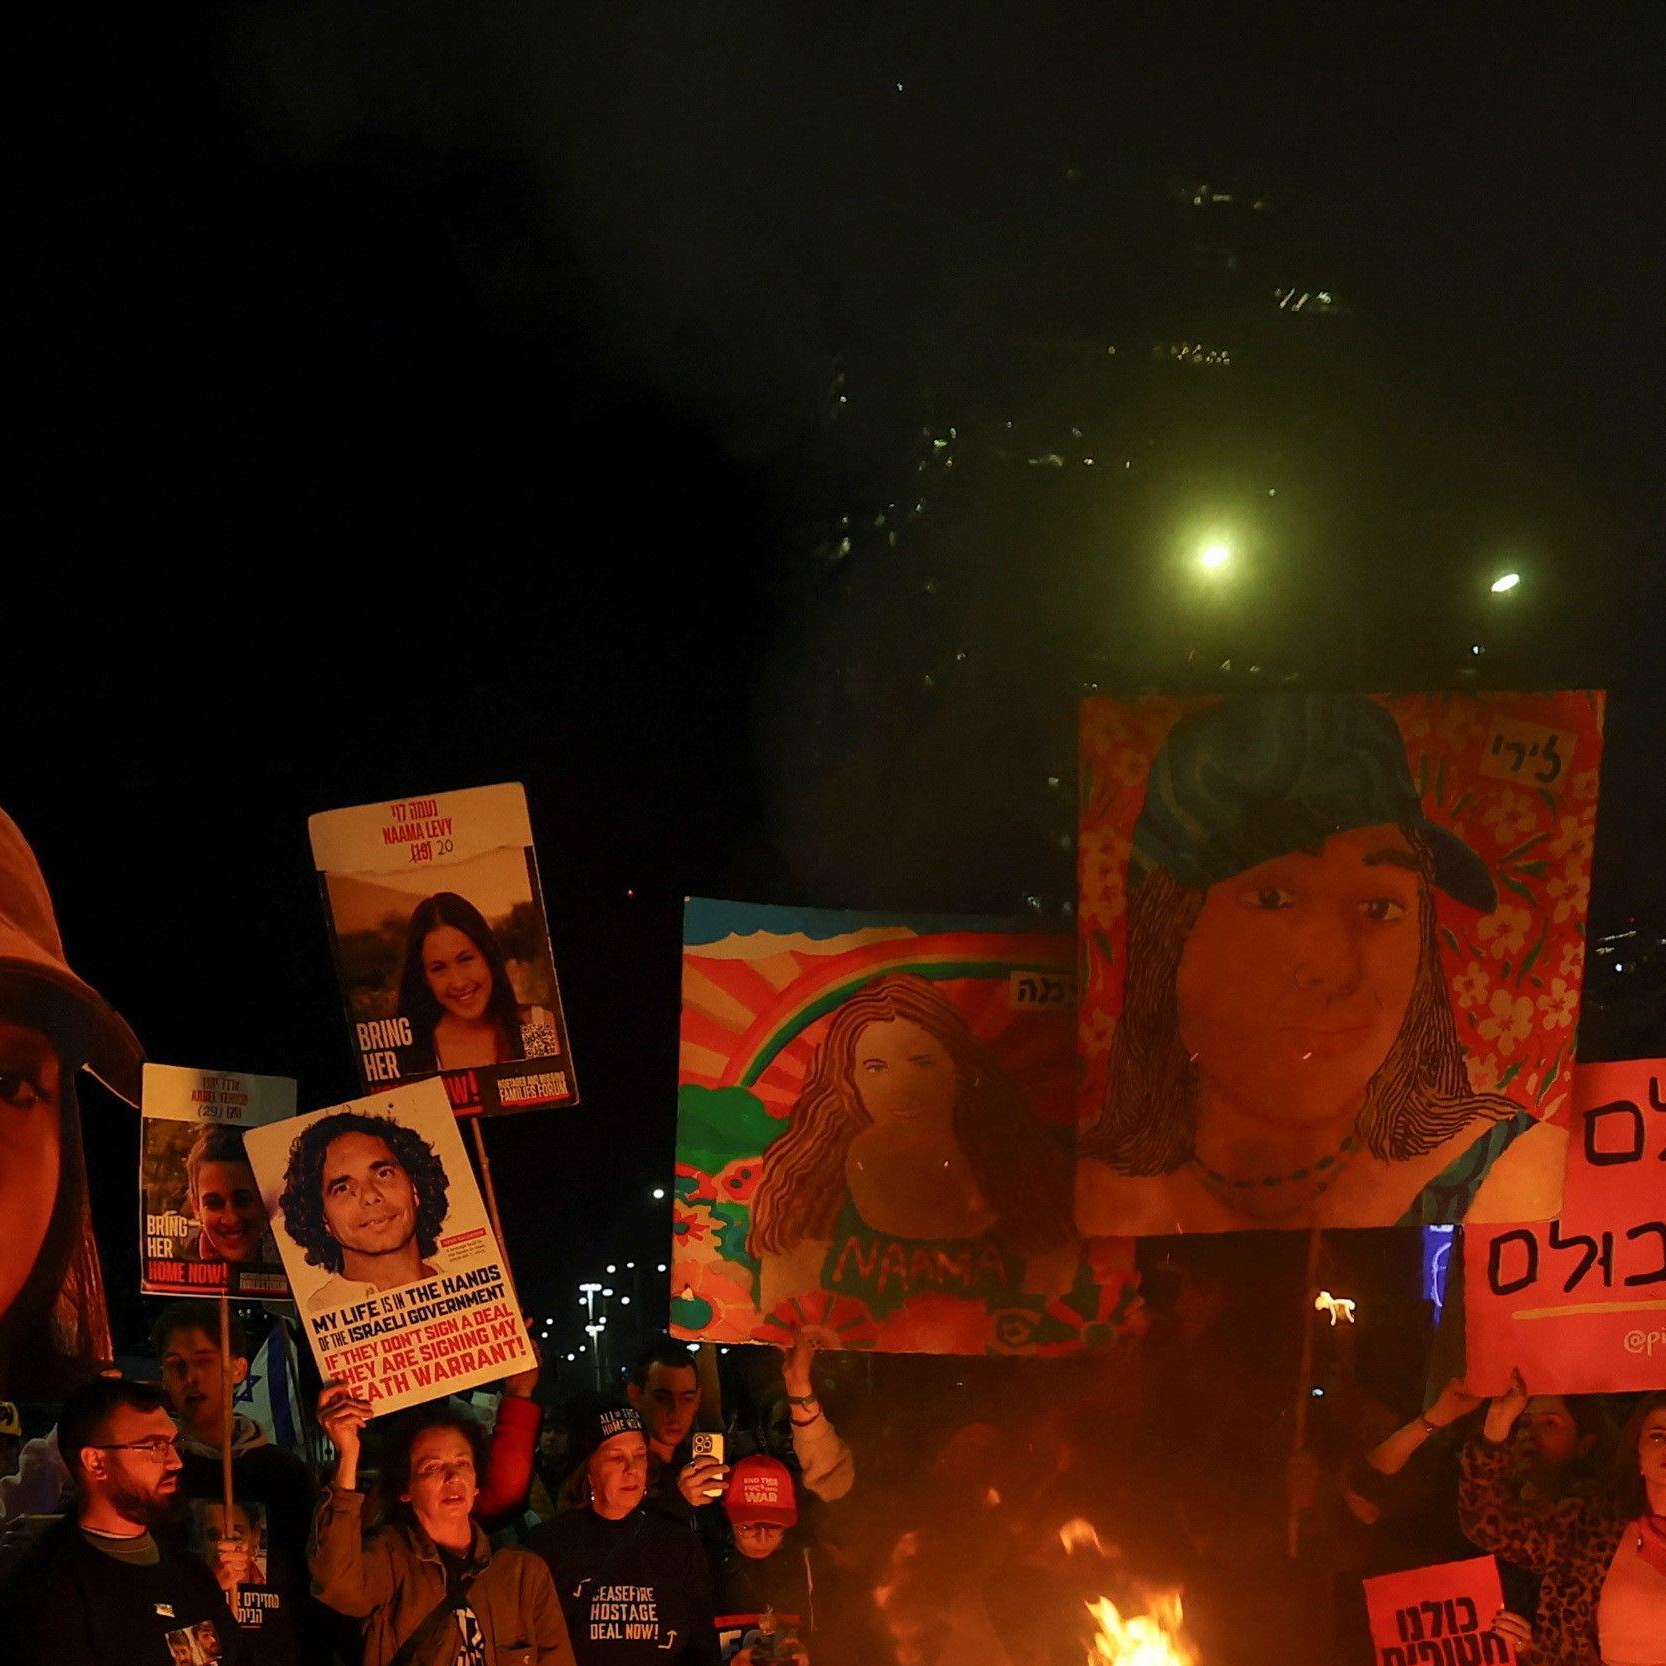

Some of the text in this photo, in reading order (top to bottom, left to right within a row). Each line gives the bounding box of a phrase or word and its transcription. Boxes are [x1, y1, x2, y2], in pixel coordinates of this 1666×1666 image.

[382, 817, 453, 845] NAAMA LEVY
[436, 839, 454, 856] 20
[356, 1017, 413, 1051] BRING
[363, 1051, 401, 1082] HER
[500, 1080, 568, 1101] FAMILIES FORUM
[146, 1214, 188, 1238] BRING
[147, 1237, 174, 1259] HER
[148, 1261, 186, 1283] HOME
[188, 1262, 229, 1286] NOW!
[311, 1264, 502, 1335] MY LIFE IS IN THE HANDS
[318, 1283, 506, 1351] OF THE ISRAELI GOVERNMENT
[324, 1302, 514, 1371] IF THEY DON'T SIGN A DEAL
[330, 1317, 518, 1385] THEY ARE SIGNING MY
[348, 1336, 527, 1401] EATH WARRANT!
[745, 1492, 778, 1503] WAR
[590, 1603, 659, 1621] HOSTAGE
[1395, 1597, 1478, 1643] כולנו
[590, 1623, 659, 1640] DEAL NOW!
